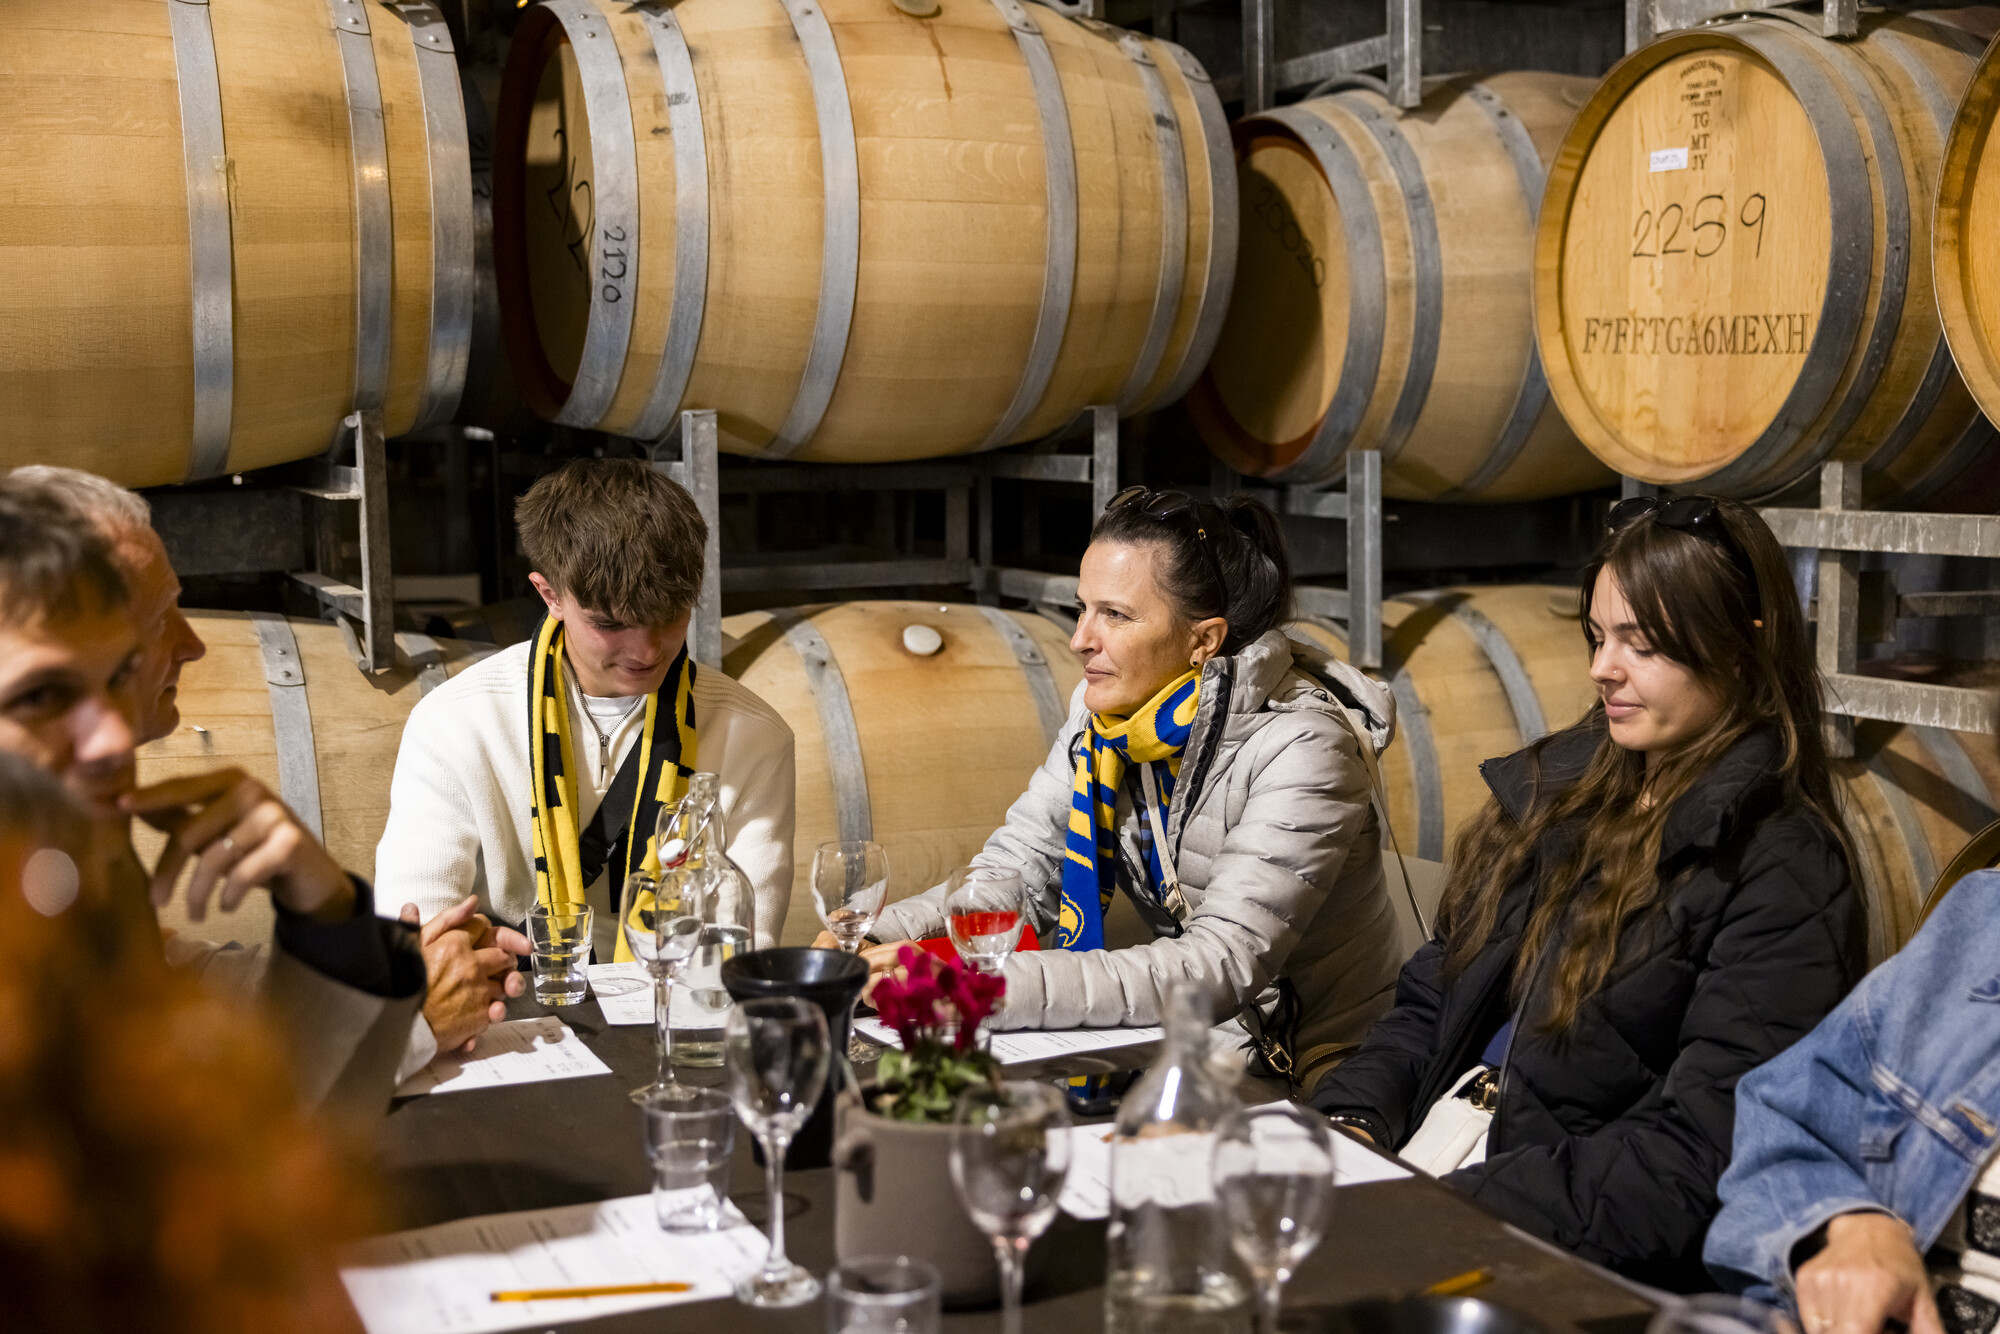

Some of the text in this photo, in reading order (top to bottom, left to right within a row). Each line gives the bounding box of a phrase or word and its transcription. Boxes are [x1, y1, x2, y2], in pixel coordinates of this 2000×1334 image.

[1692, 111, 1710, 129] TG
[1690, 133, 1710, 150] MT
[1691, 153, 1708, 171] JY
[1632, 192, 1767, 259] 2259
[601, 226, 627, 304] 2120
